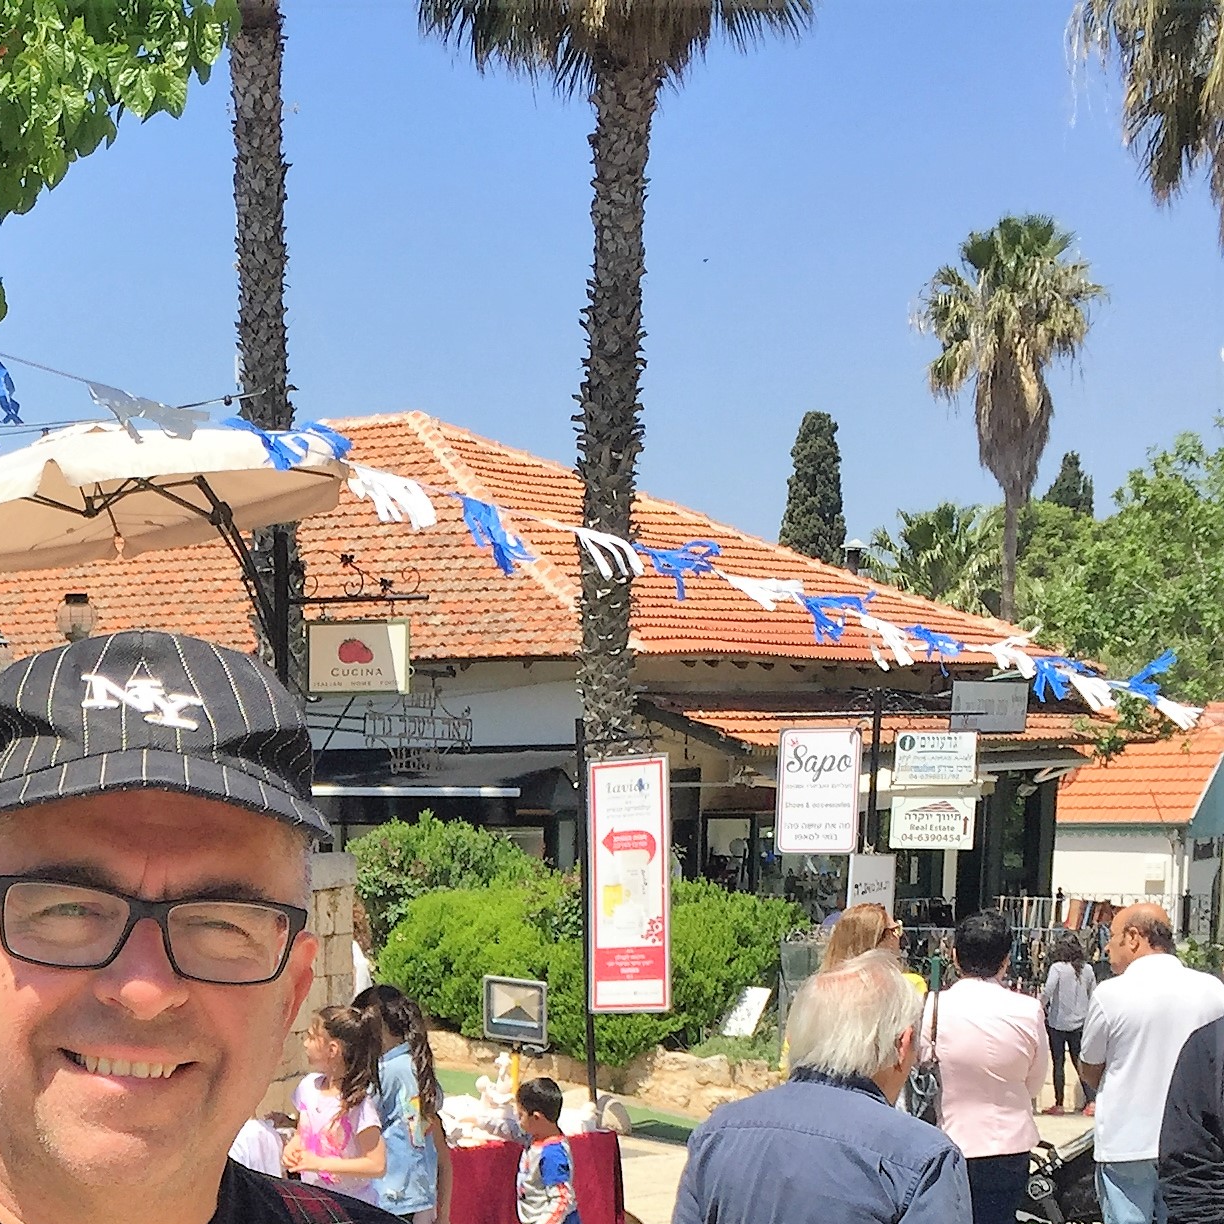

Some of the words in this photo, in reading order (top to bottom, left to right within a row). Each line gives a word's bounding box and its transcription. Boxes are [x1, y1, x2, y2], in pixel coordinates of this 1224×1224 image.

[330, 667, 384, 678] CUCINA
[786, 744, 853, 783] Sapo
[904, 813, 933, 823] יוקרה
[937, 812, 961, 823] תיווך
[909, 823, 928, 832] Real
[929, 823, 956, 832] Estate
[901, 833, 961, 842] 04-6390454
